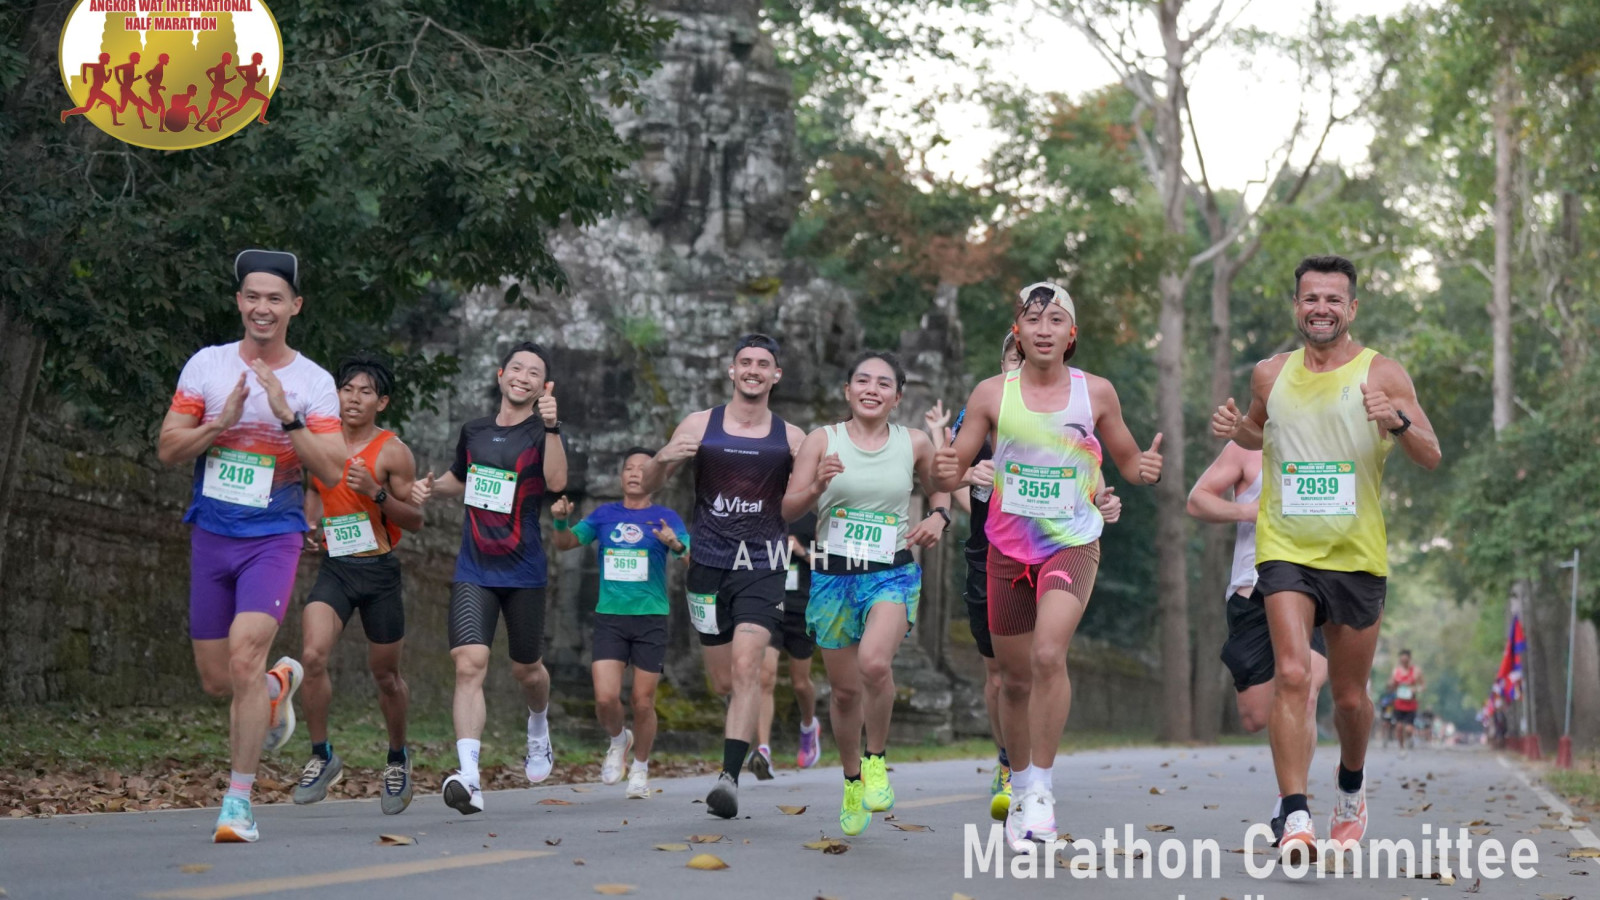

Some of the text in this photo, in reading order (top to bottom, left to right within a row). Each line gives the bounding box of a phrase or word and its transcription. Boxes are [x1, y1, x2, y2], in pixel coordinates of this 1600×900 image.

[218, 462, 255, 486] 2418
[474, 477, 502, 496] 3570
[1018, 479, 1060, 499] 3554
[1296, 477, 1339, 495] 2939
[724, 496, 763, 513] Vital
[333, 524, 362, 542] 3573
[844, 522, 882, 542] 2870
[613, 557, 637, 570] 3619
